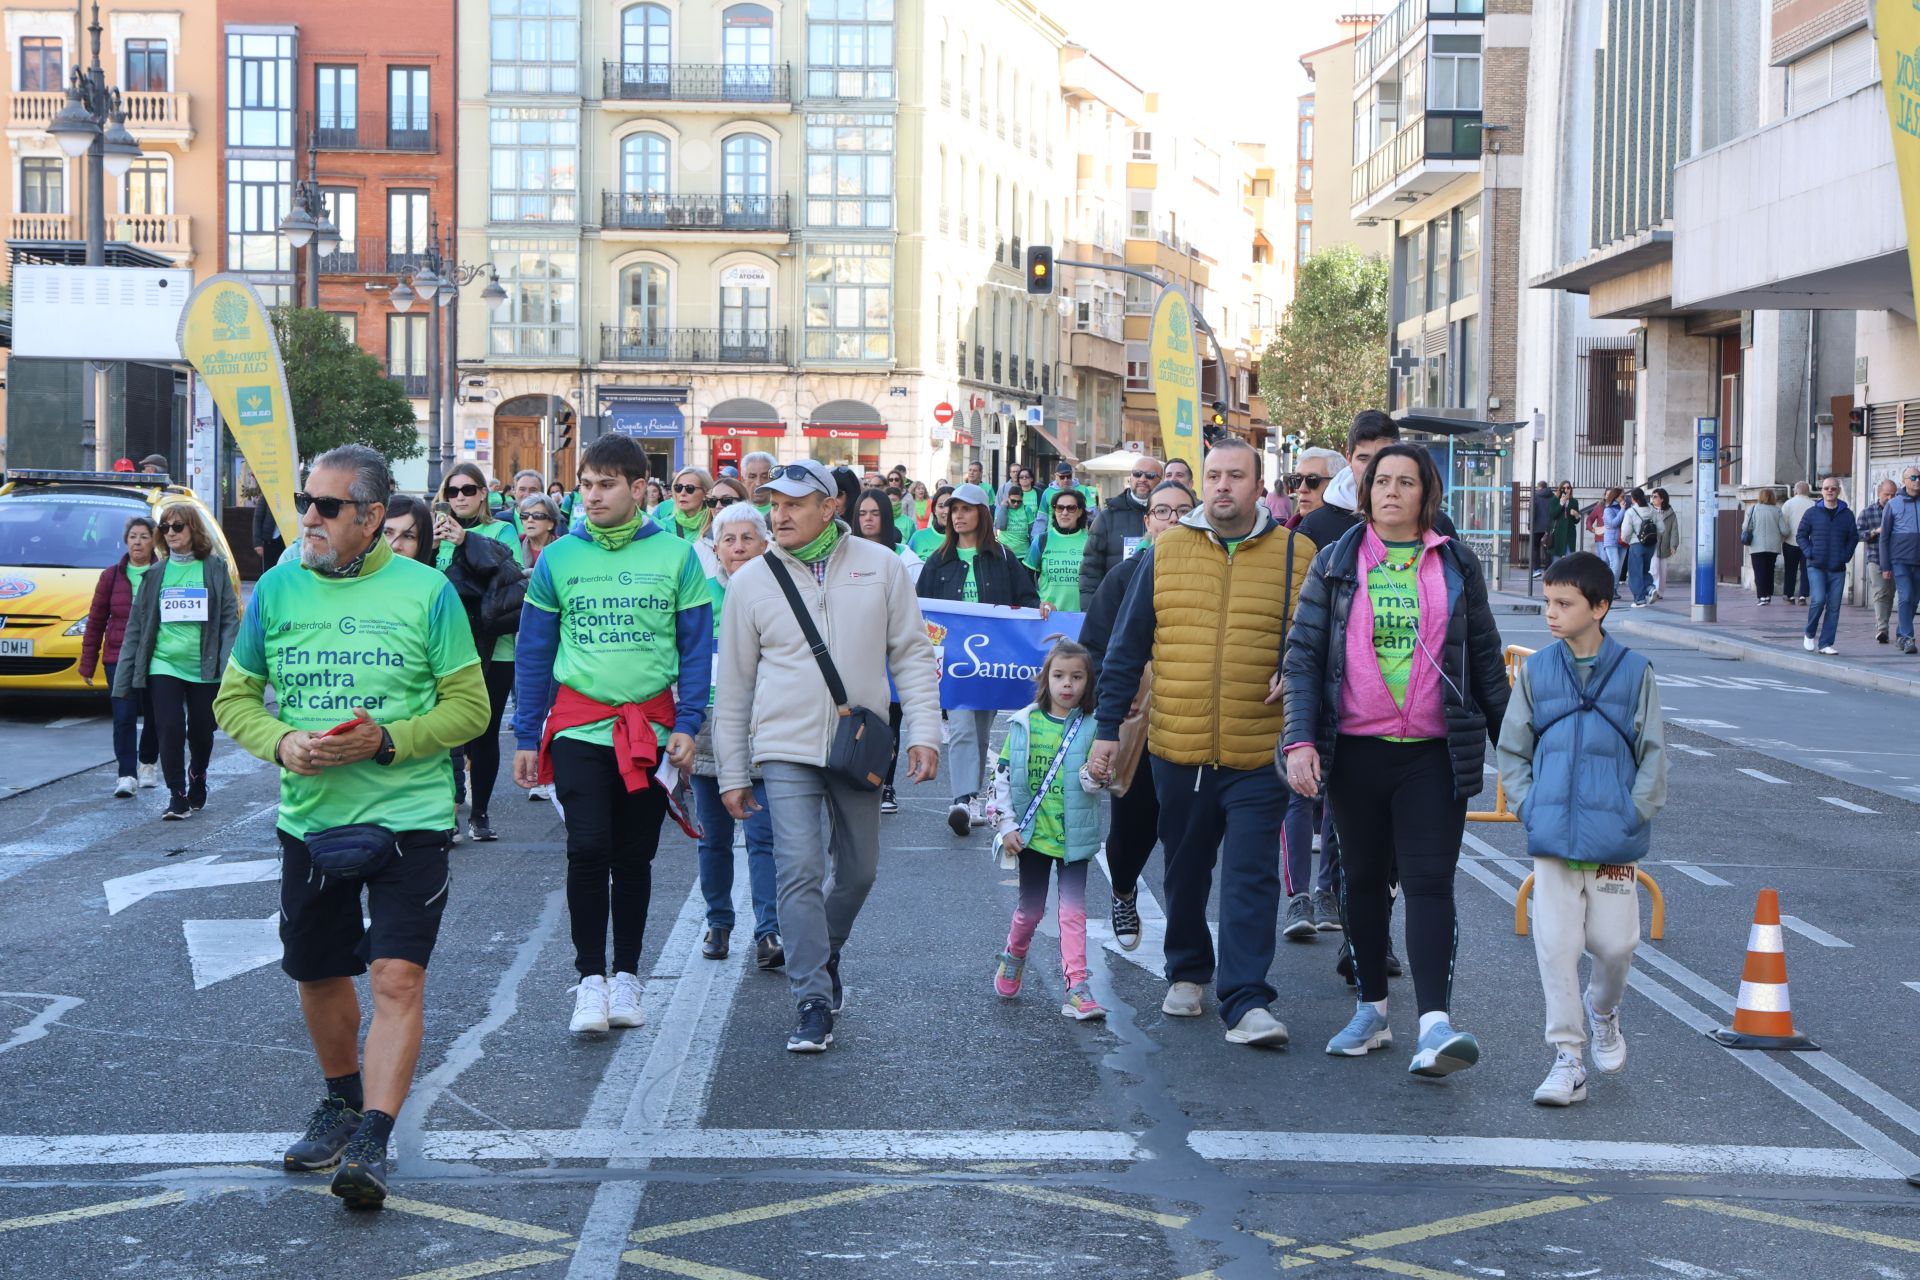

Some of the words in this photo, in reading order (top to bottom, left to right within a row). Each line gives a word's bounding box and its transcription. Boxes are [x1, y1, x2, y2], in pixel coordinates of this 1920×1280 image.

[165, 600, 201, 610] 20631
[576, 595, 597, 611] En
[602, 594, 669, 610] marcha
[577, 612, 634, 627] contra
[1374, 611, 1419, 629] ntra
[579, 629, 595, 644] el
[598, 628, 656, 643] cáncer
[285, 647, 310, 665] En
[317, 648, 404, 667] marcha
[948, 634, 1043, 680] Santov
[284, 669, 355, 687] contra
[287, 690, 303, 709] el
[309, 691, 387, 710] cáncer
[1595, 863, 1634, 884] BROOKLYN
